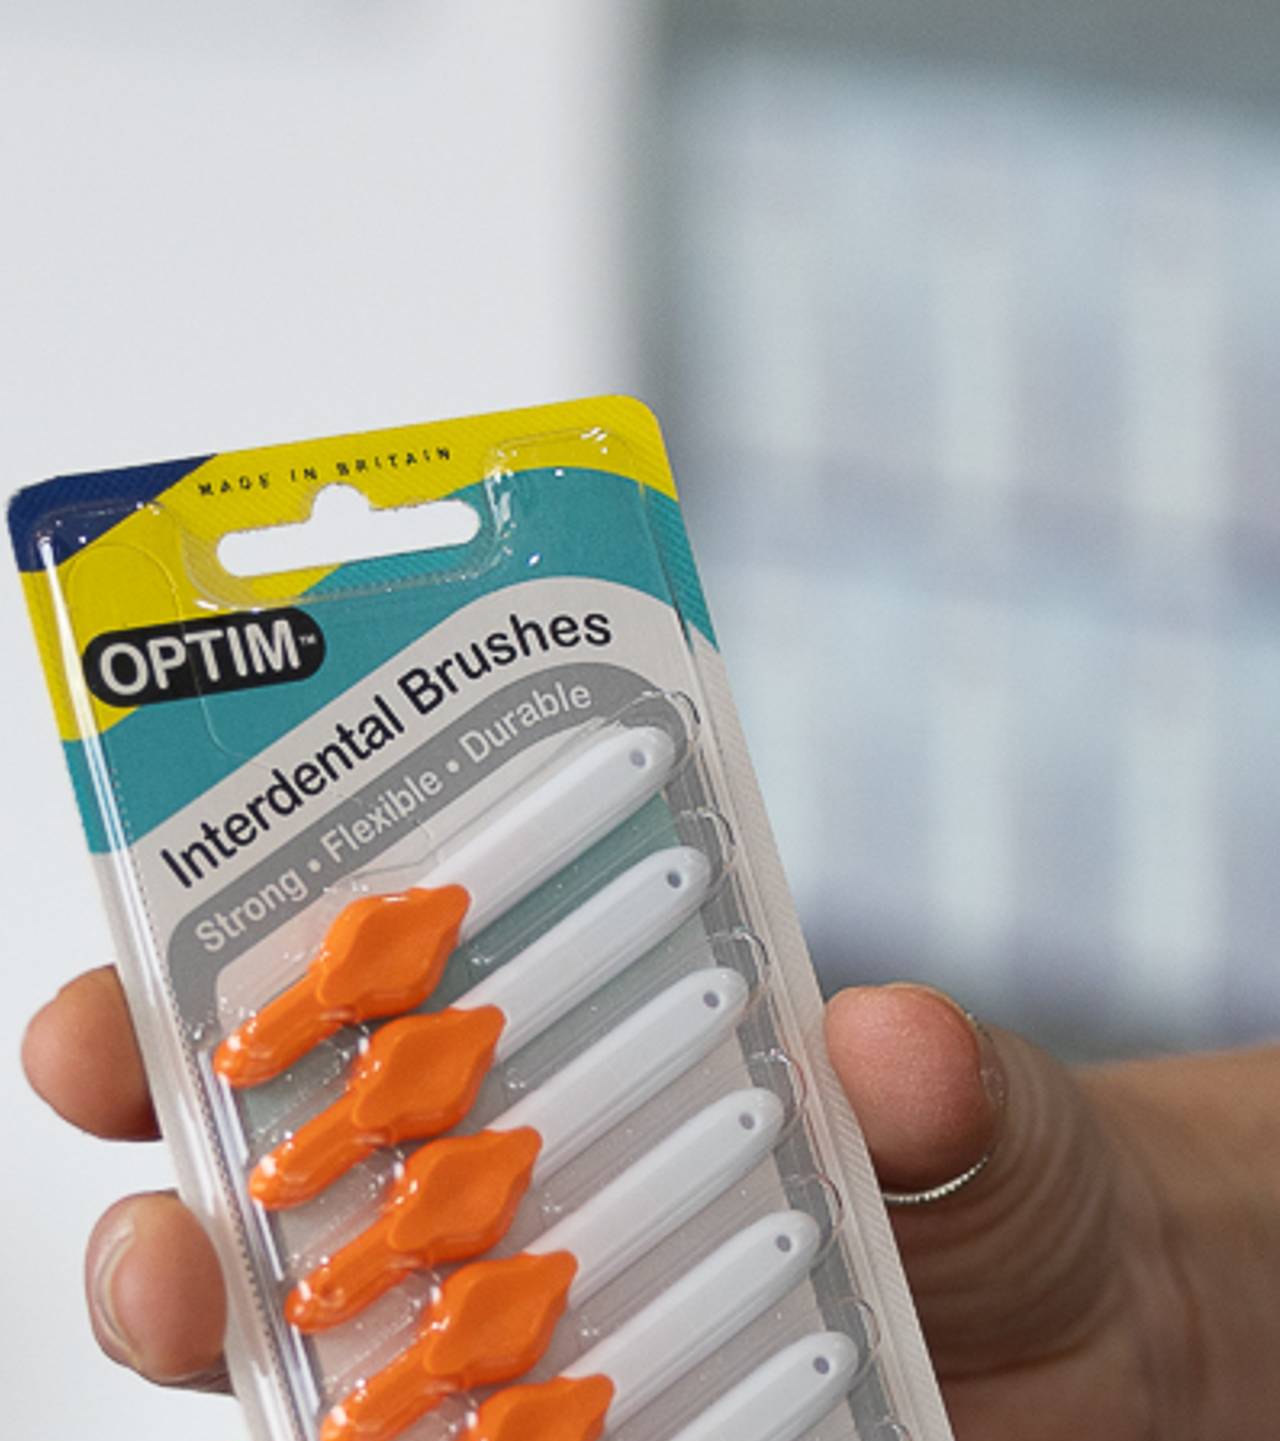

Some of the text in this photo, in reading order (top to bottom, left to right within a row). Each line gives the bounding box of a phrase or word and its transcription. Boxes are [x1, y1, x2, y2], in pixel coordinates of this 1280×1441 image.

[197, 446, 452, 497] MADE IN BRITAIN
[99, 618, 302, 697] OPTIM
[159, 612, 613, 889] Interdental Brushes
[194, 680, 593, 953] Strong Flexible Durable
